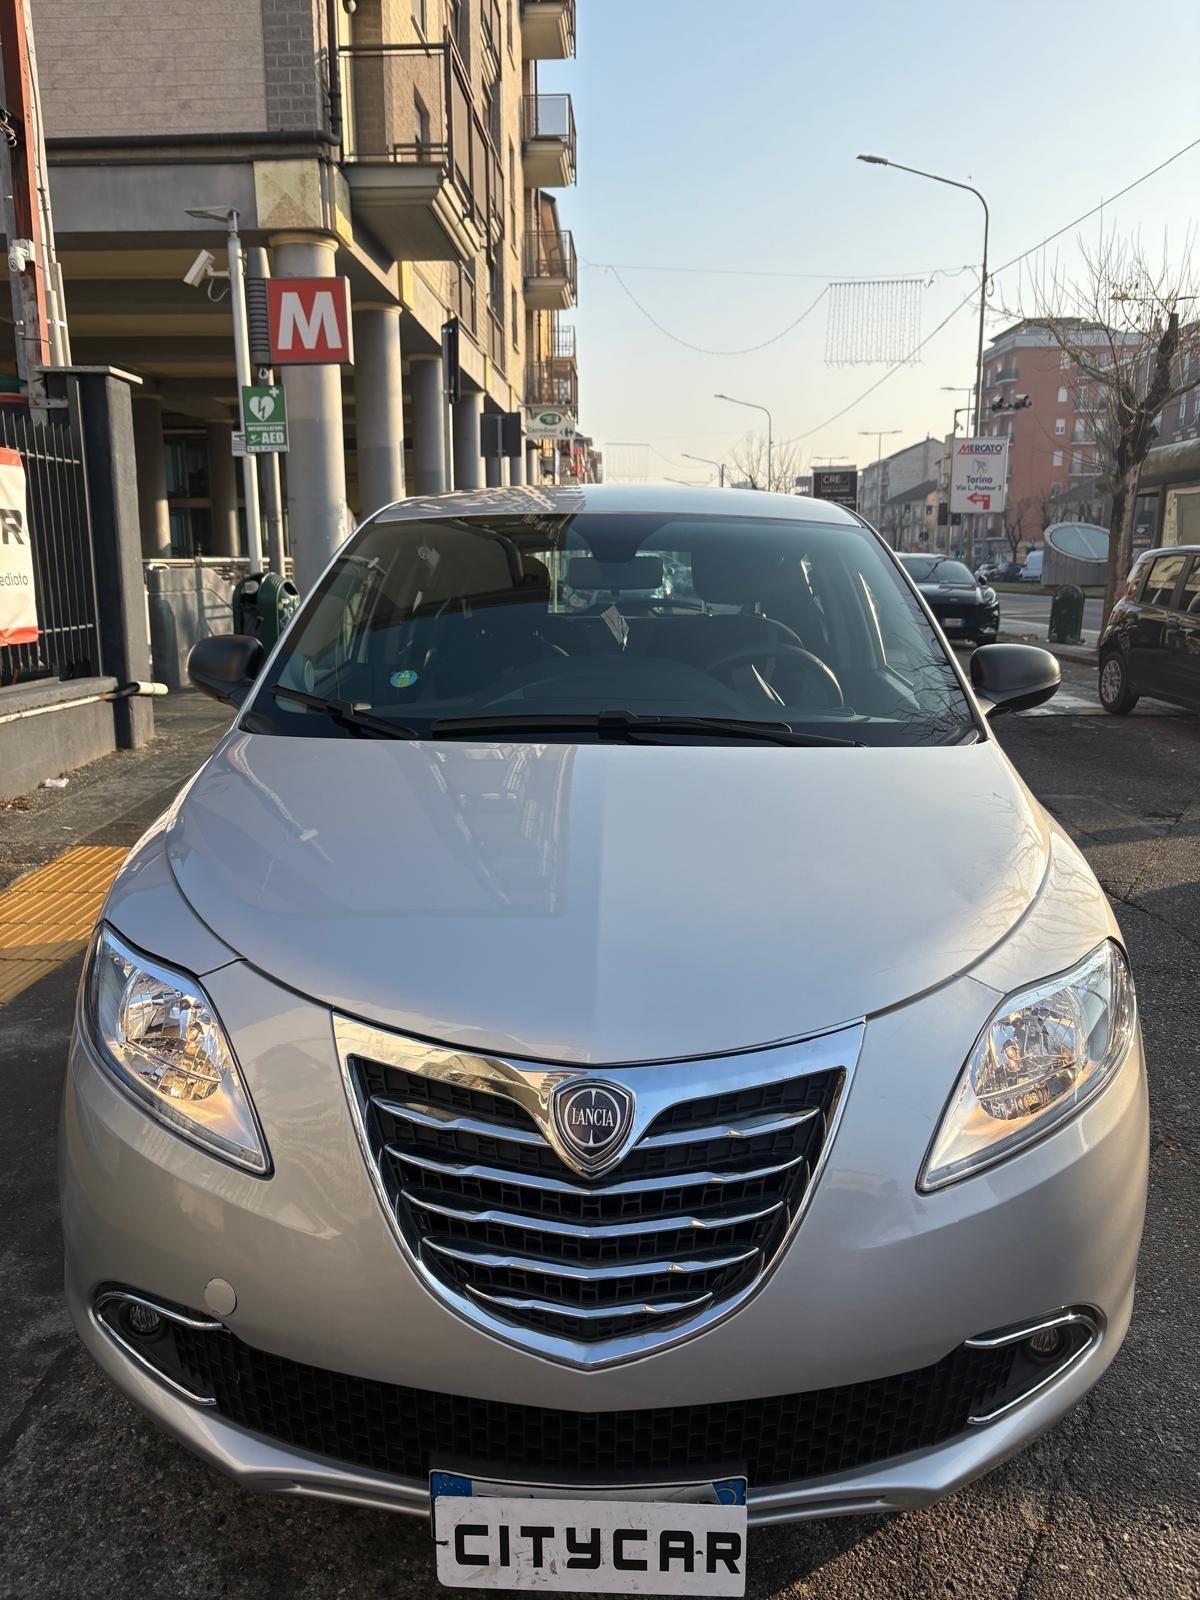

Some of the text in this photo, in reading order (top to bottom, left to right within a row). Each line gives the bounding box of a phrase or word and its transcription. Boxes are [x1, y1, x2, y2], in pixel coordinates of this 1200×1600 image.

[277, 291, 343, 350] M
[261, 431, 285, 444] AED
[966, 475, 993, 484] Torino
[571, 1107, 615, 1127] LANCIA
[454, 1523, 742, 1575] CITYCAR
